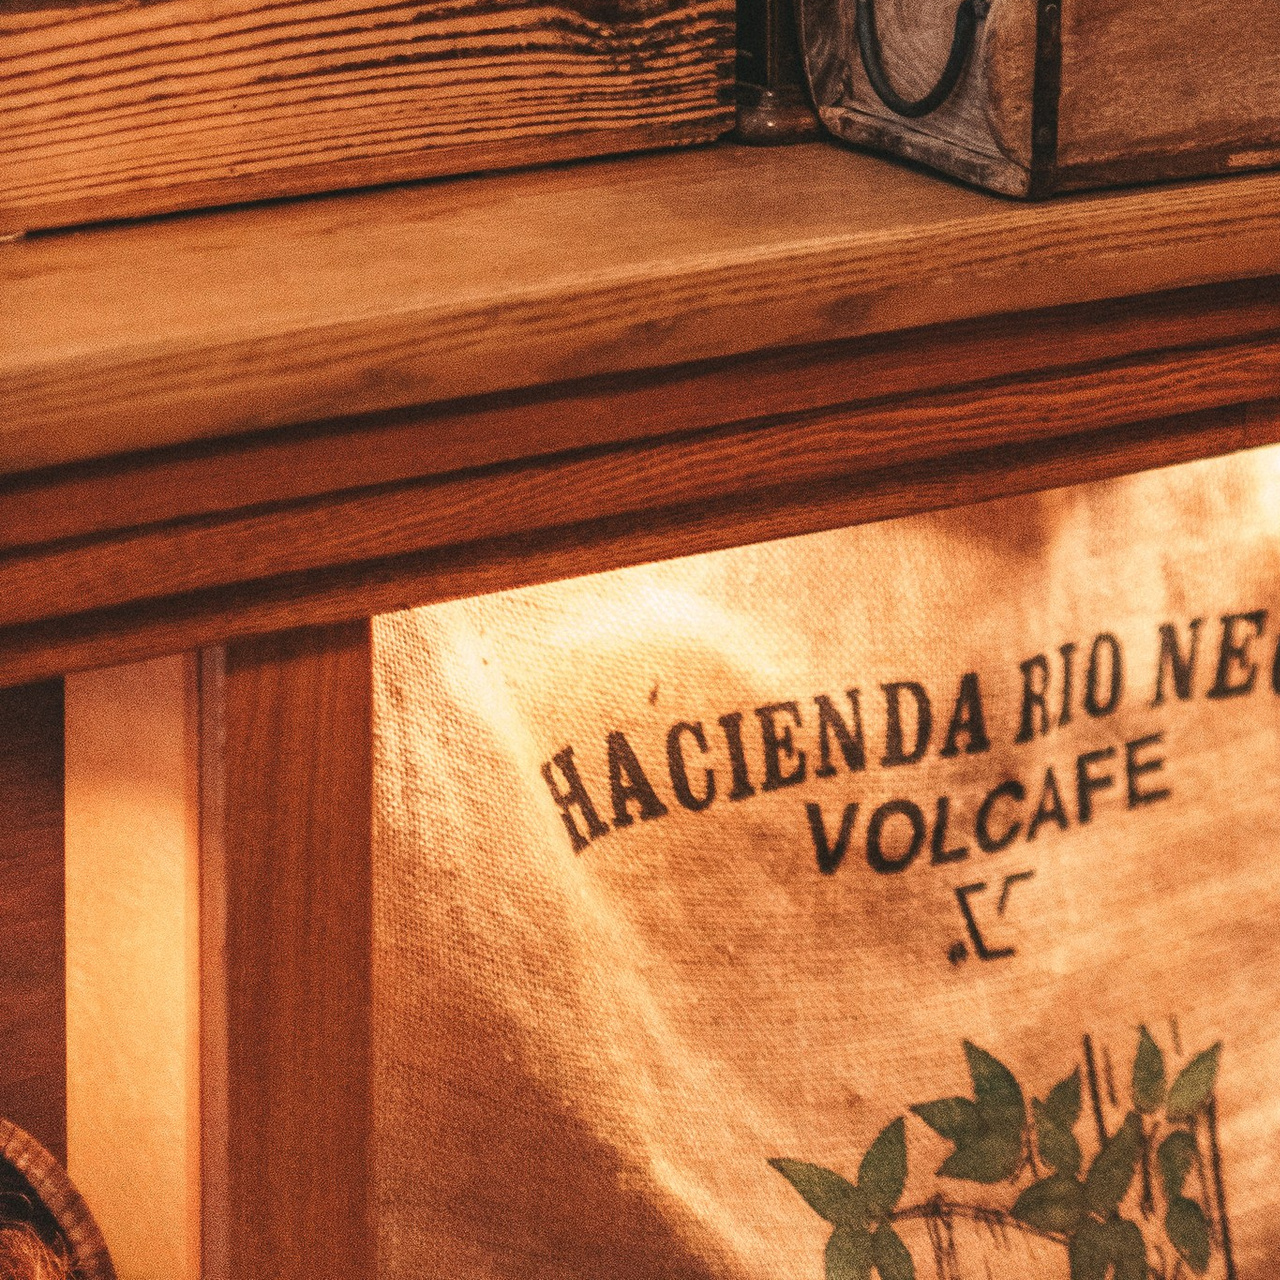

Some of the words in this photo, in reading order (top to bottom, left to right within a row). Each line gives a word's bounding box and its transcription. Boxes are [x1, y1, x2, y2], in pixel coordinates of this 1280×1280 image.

[541, 671, 992, 853] HACIENDA
[1015, 630, 1125, 746] RIO
[802, 732, 1174, 877] VOLCAFE
